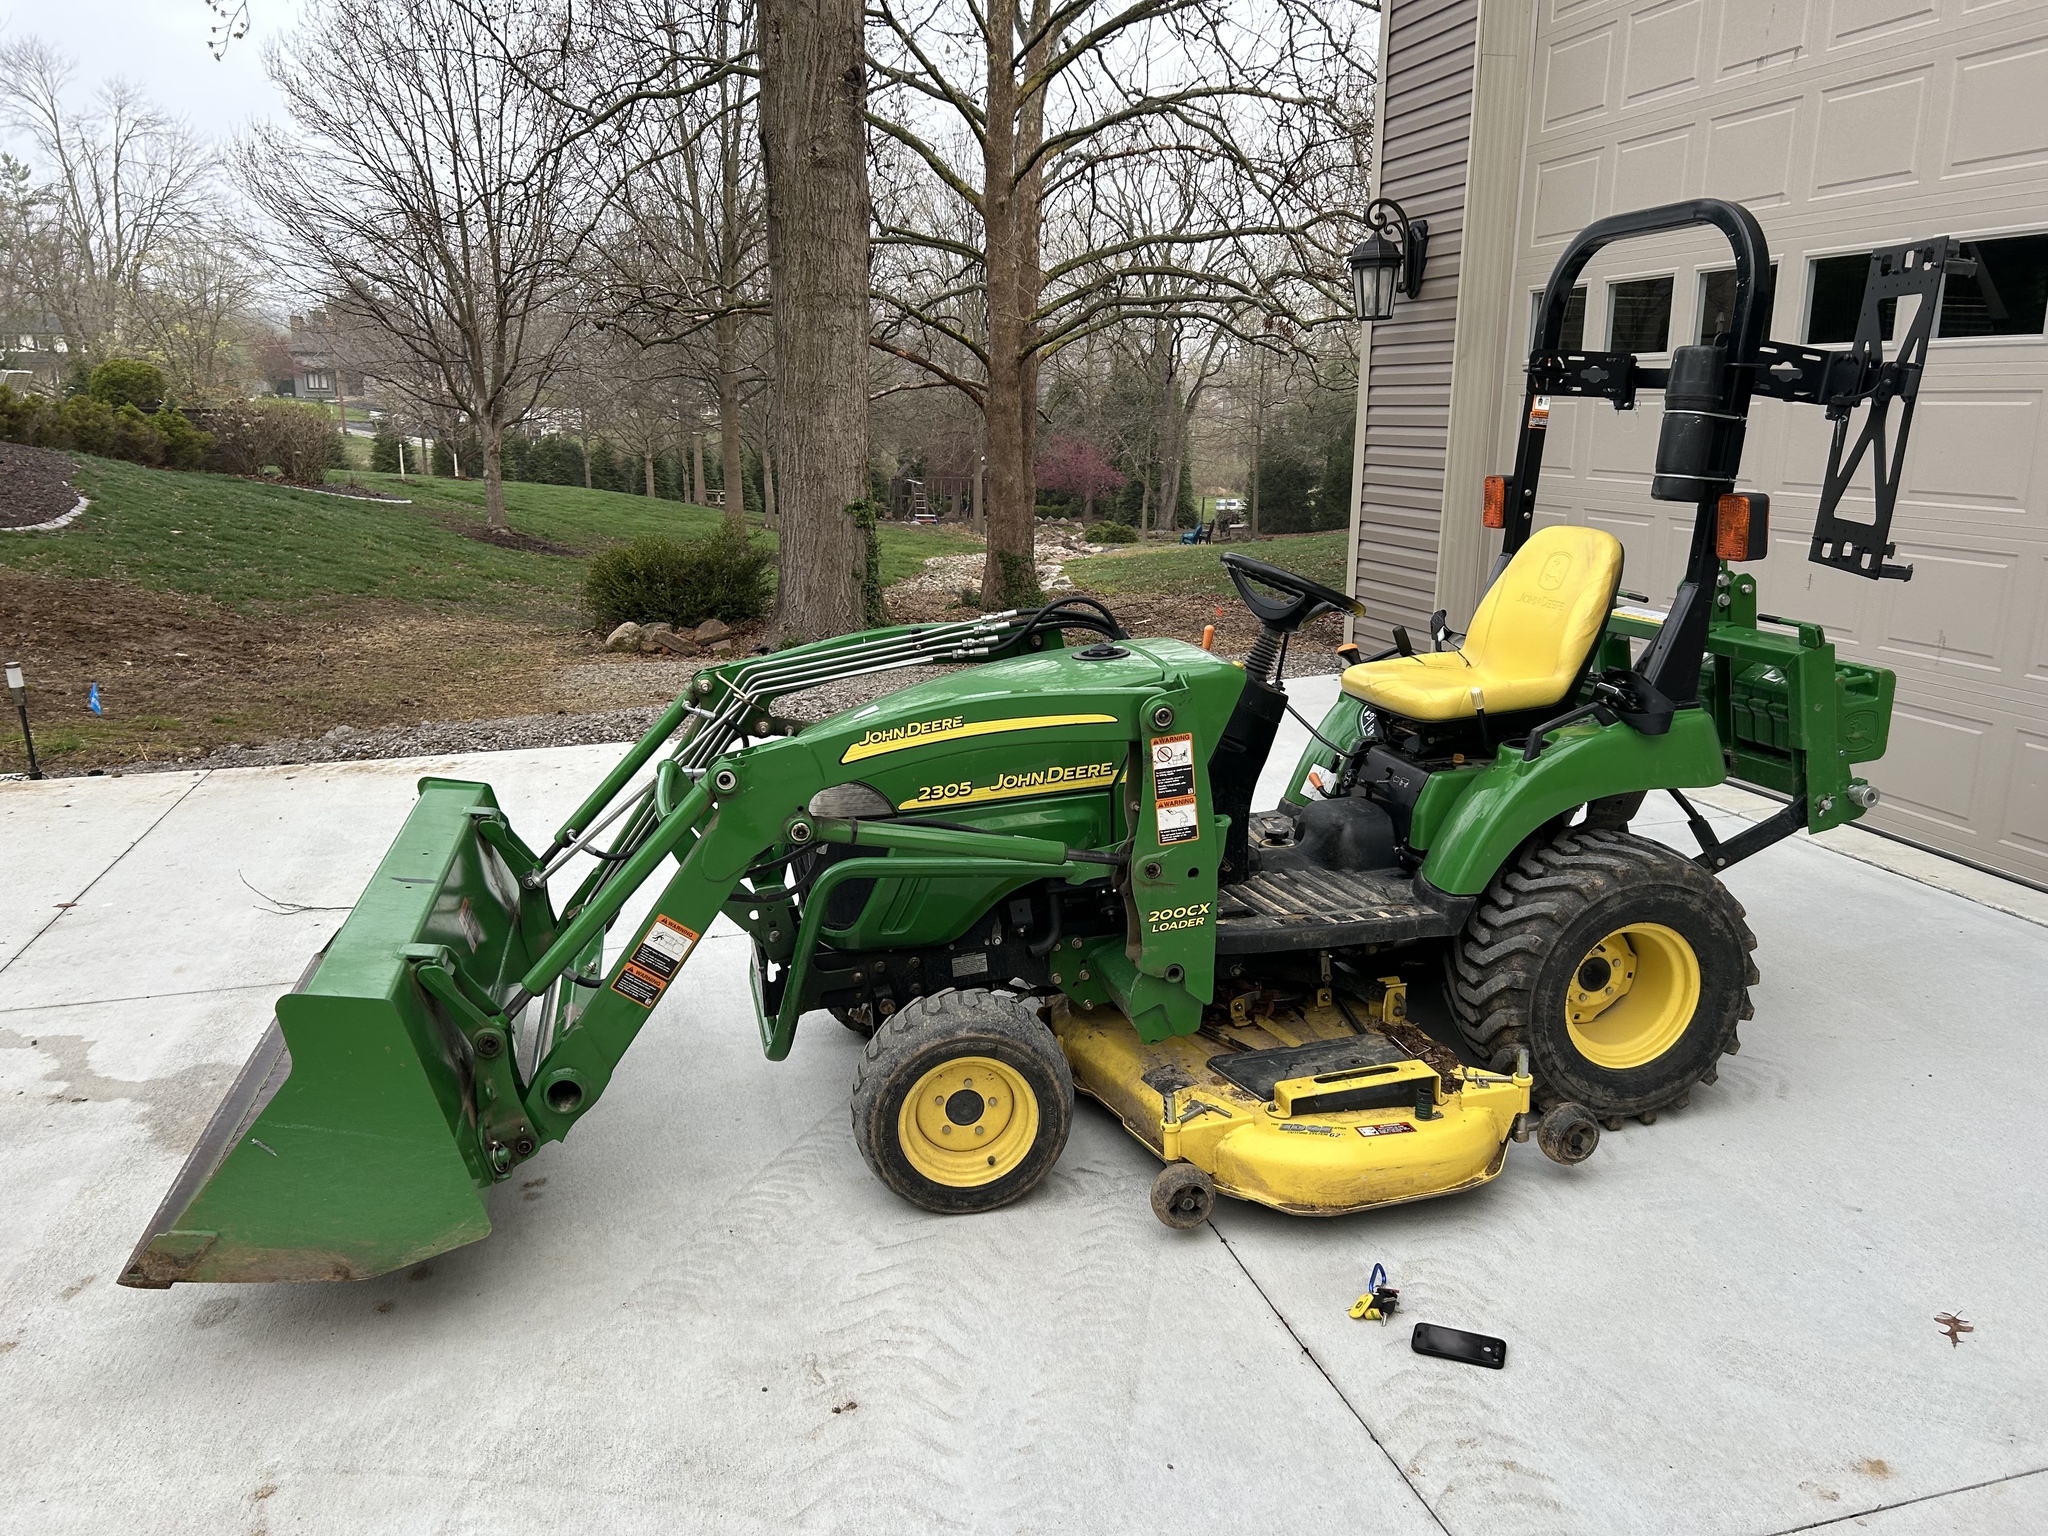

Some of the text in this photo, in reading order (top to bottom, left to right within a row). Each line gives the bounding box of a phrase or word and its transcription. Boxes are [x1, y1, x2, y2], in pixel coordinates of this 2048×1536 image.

[859, 716, 963, 745] JOHN DEERE
[1159, 734, 1190, 744] WARNING
[917, 762, 1113, 801] 2305 JOHN DEERE
[1163, 798, 1194, 807] WARNING
[1148, 902, 1212, 923] 200CX
[668, 922, 693, 938] WARNING
[1151, 917, 1206, 933] LOADER
[636, 970, 661, 986] WARNING
